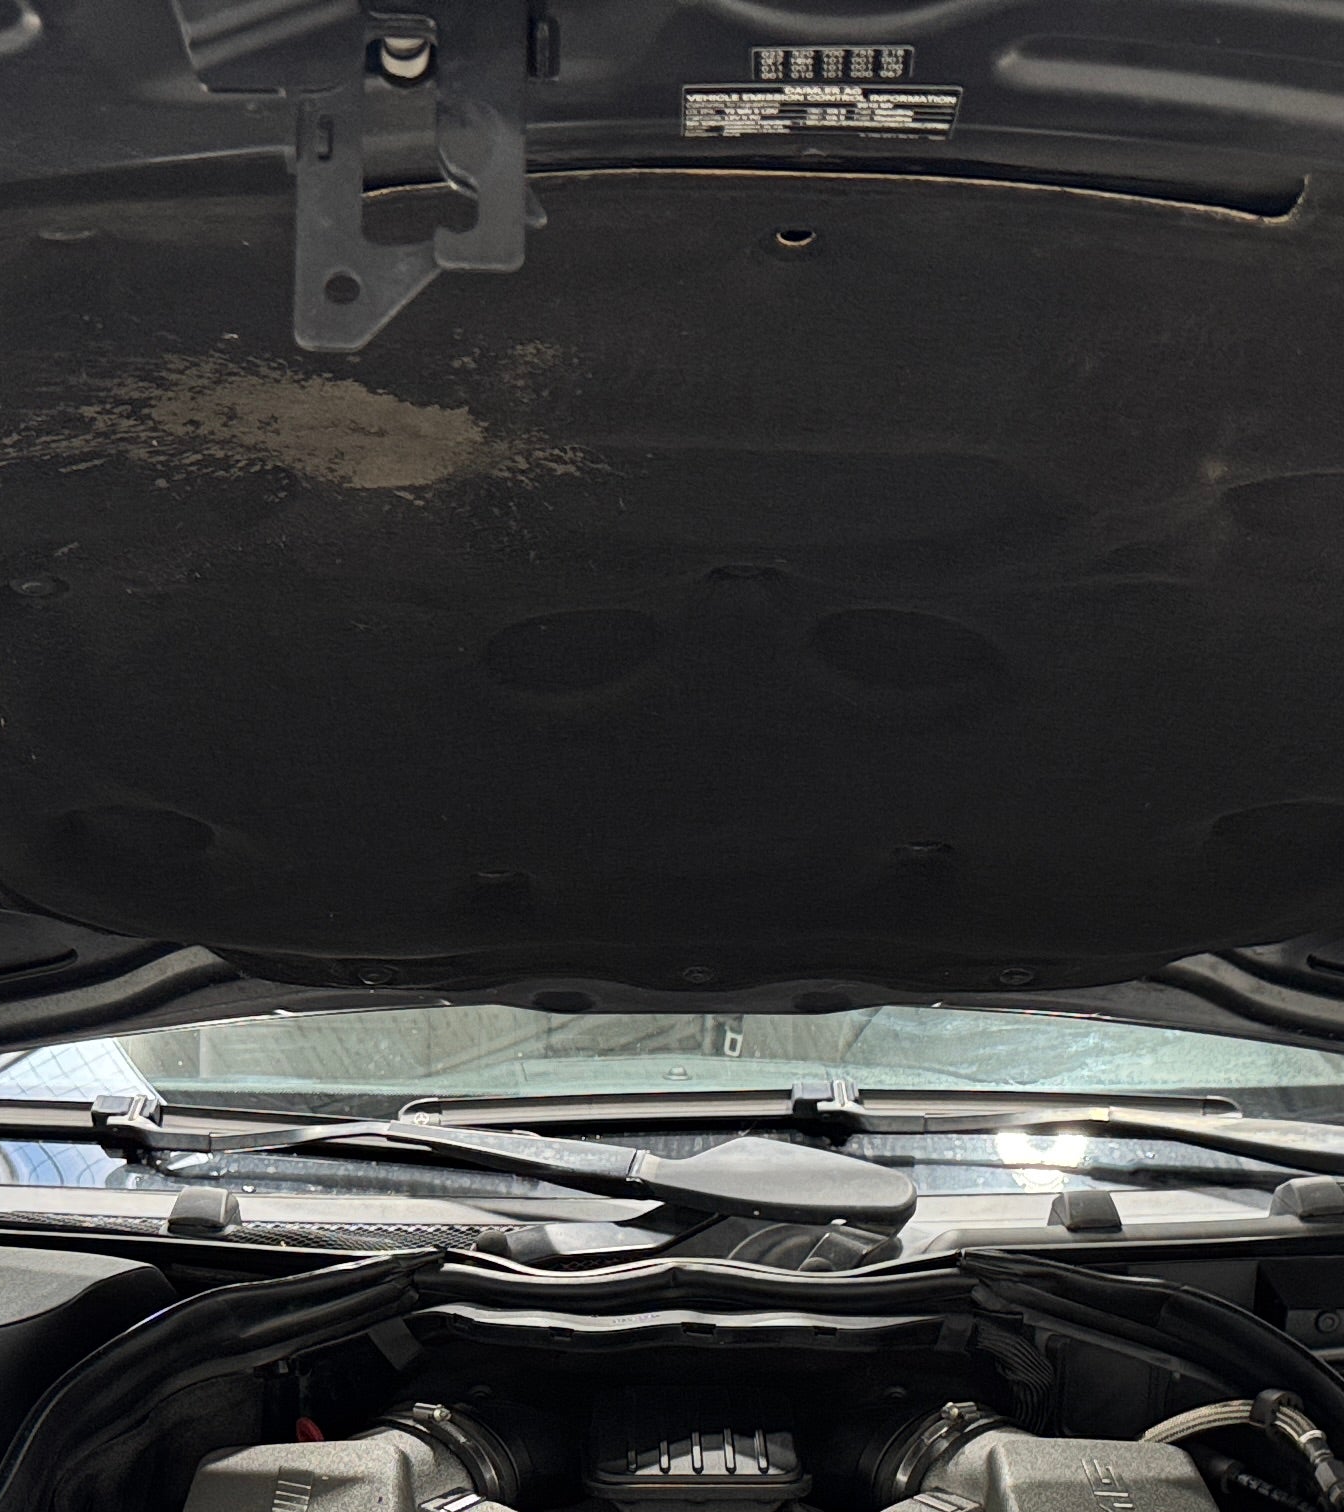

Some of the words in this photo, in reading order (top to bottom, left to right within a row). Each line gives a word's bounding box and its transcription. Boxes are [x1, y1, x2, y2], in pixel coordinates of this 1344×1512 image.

[784, 87, 840, 95] DAIMLER
[844, 87, 862, 95] AG
[686, 94, 740, 102] VEHICLE
[742, 94, 804, 102] EMISSION
[869, 95, 956, 104] INFORMATION
